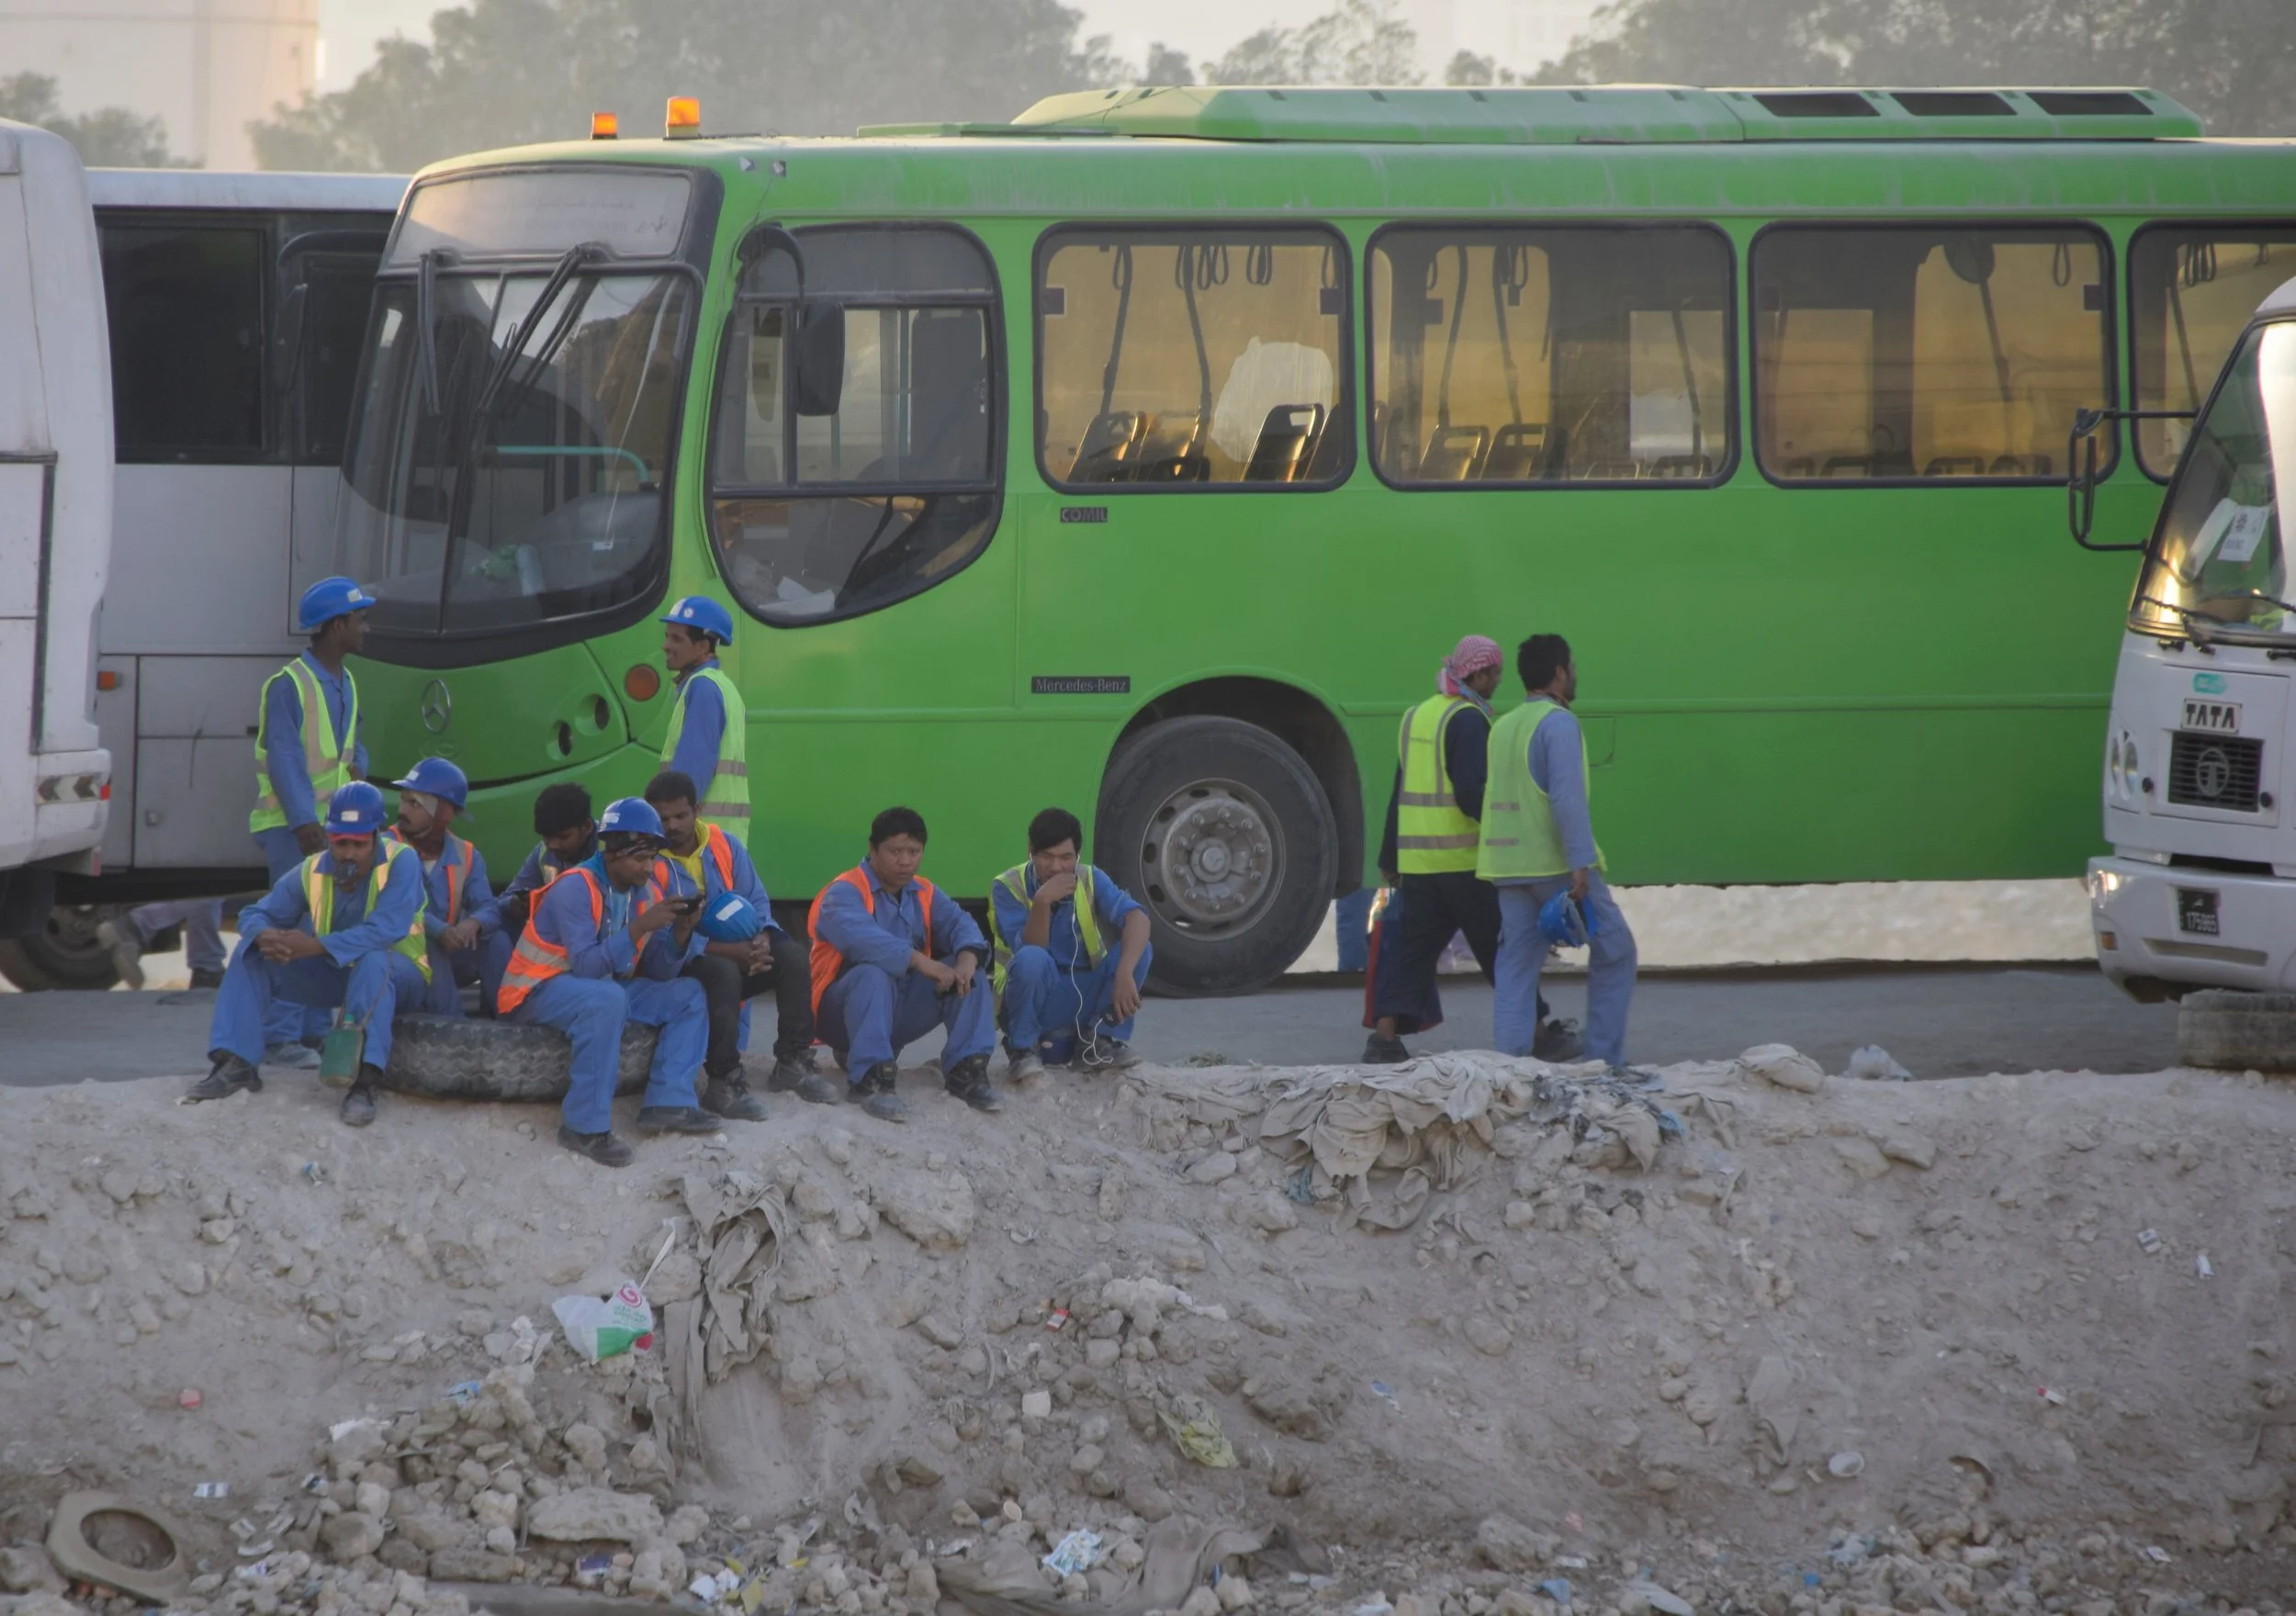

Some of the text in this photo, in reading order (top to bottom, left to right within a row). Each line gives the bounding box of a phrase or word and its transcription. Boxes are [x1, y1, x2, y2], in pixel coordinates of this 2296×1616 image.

[1062, 508, 1107, 522] COMIL
[1035, 678, 1127, 692] Mercedes-Benz
[2186, 703, 2235, 729] TATA
